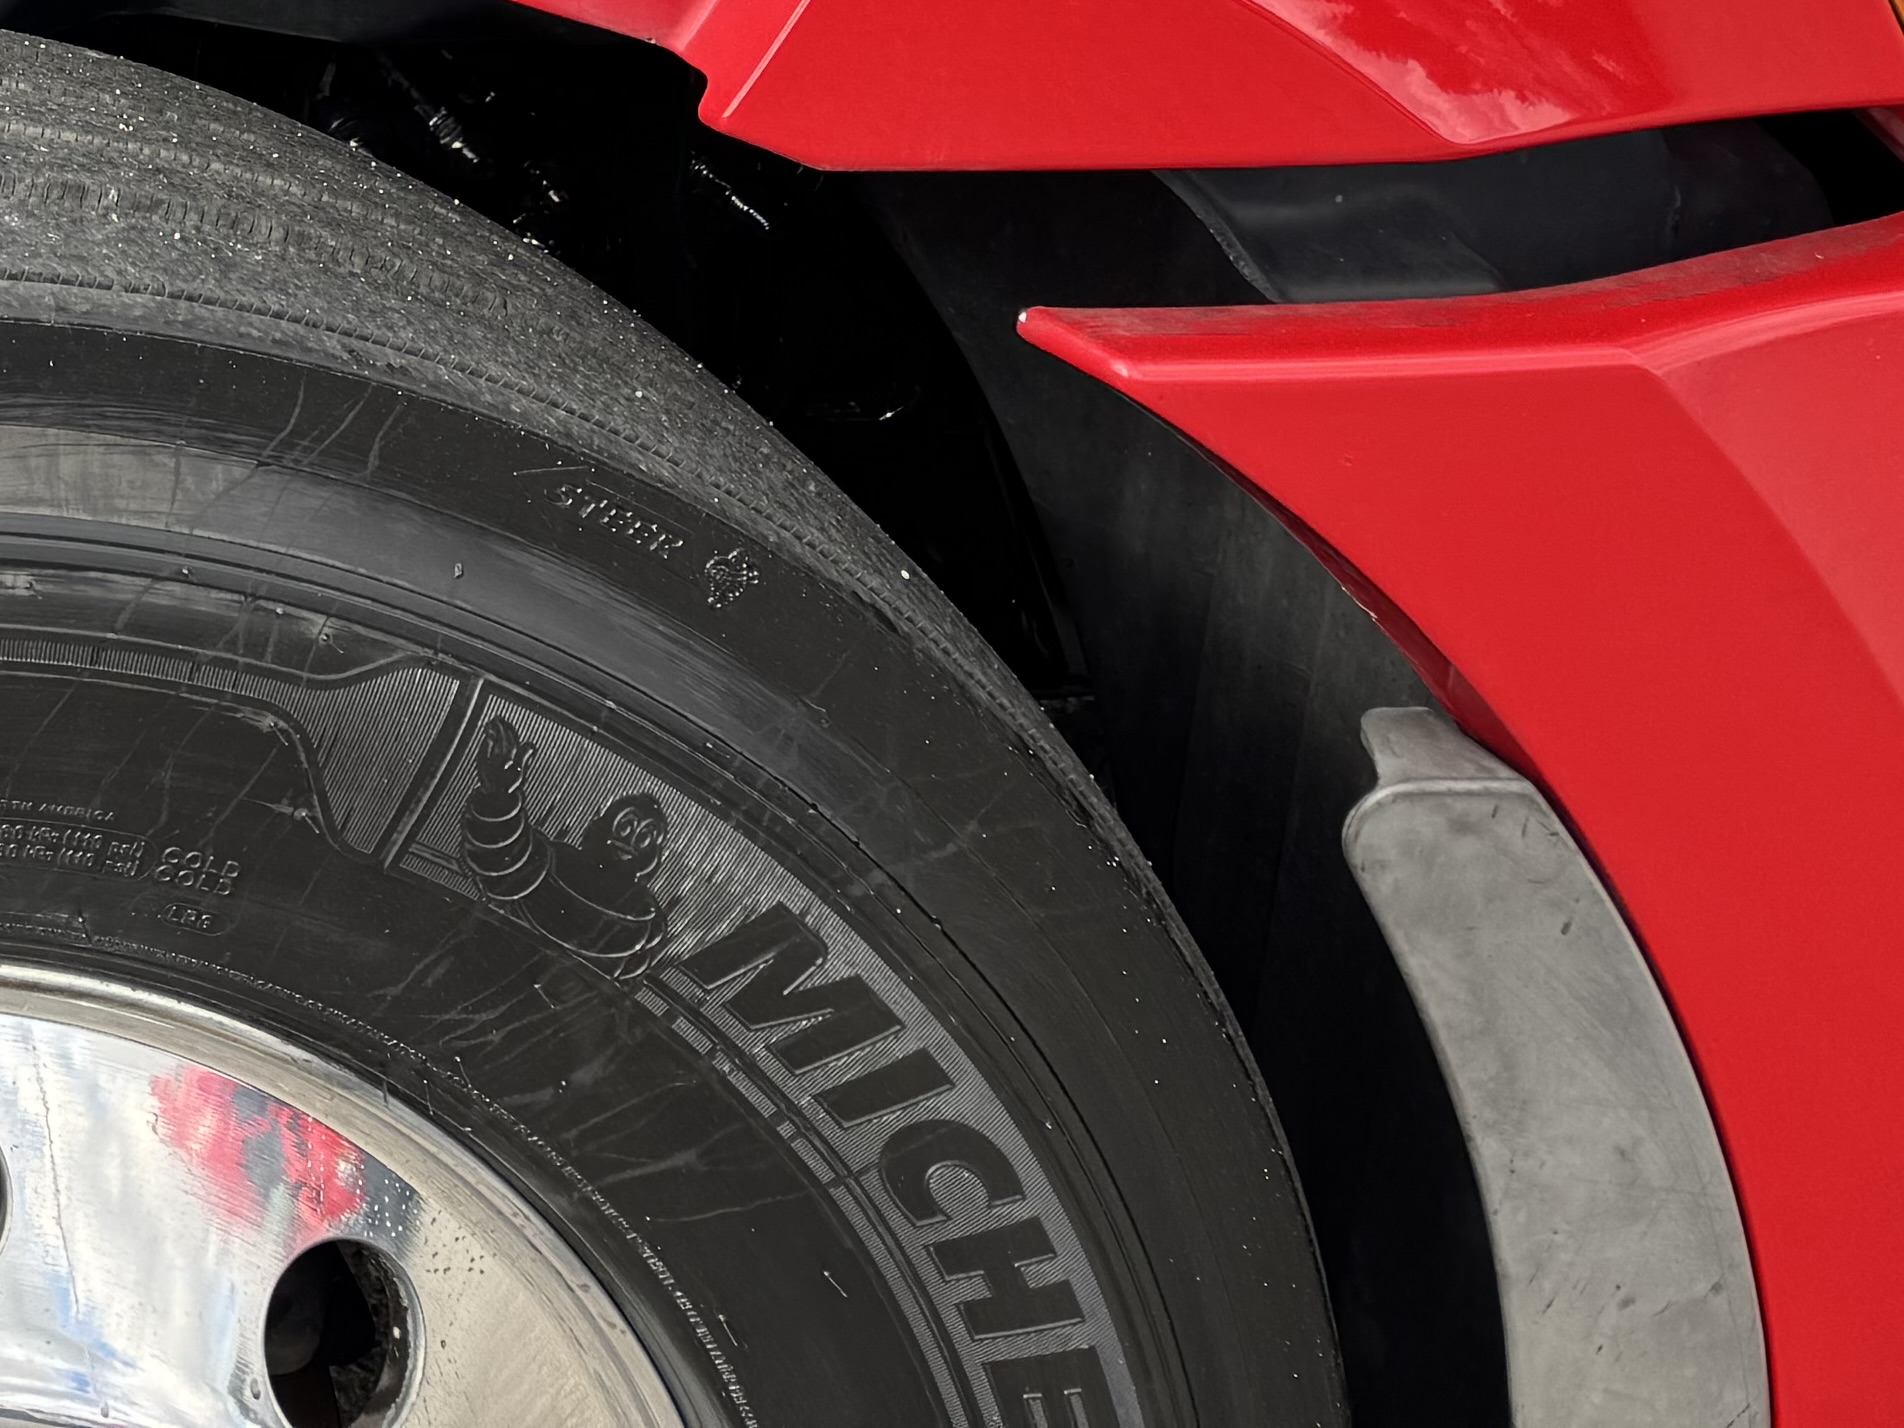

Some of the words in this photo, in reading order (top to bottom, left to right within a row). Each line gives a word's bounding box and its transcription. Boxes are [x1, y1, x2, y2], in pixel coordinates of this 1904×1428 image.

[544, 484, 684, 559] STEER
[39, 802, 116, 822] AMERICA
[161, 846, 240, 878] COLD
[154, 865, 232, 896] COLD
